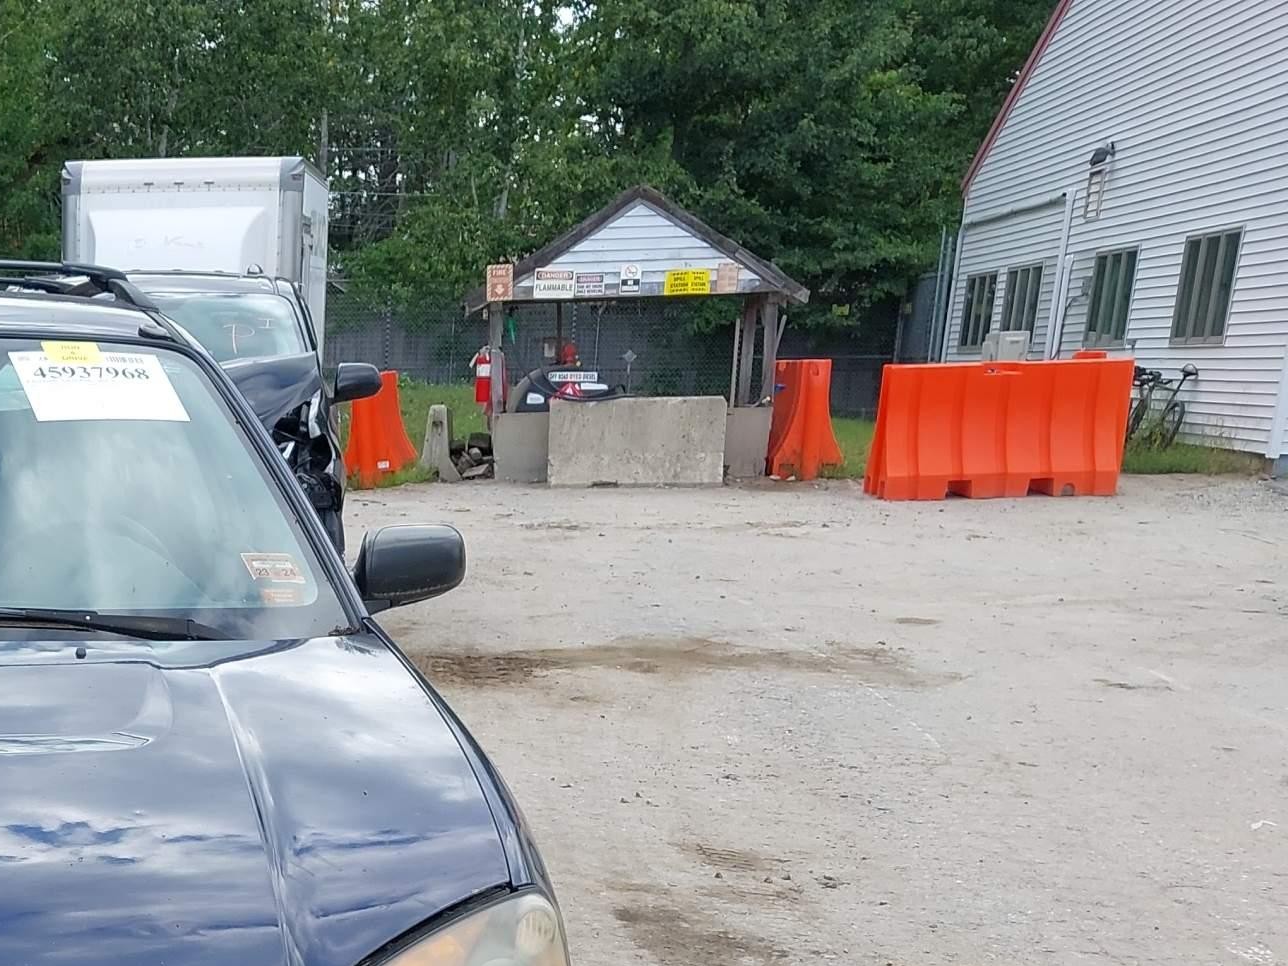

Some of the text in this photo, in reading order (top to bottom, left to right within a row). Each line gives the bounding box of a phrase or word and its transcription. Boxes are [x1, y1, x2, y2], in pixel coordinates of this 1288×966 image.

[540, 271, 570, 279] DANGER
[535, 283, 573, 292] FLAMMABLE
[33, 366, 150, 380] 45937968
[256, 568, 297, 577] 23 24
